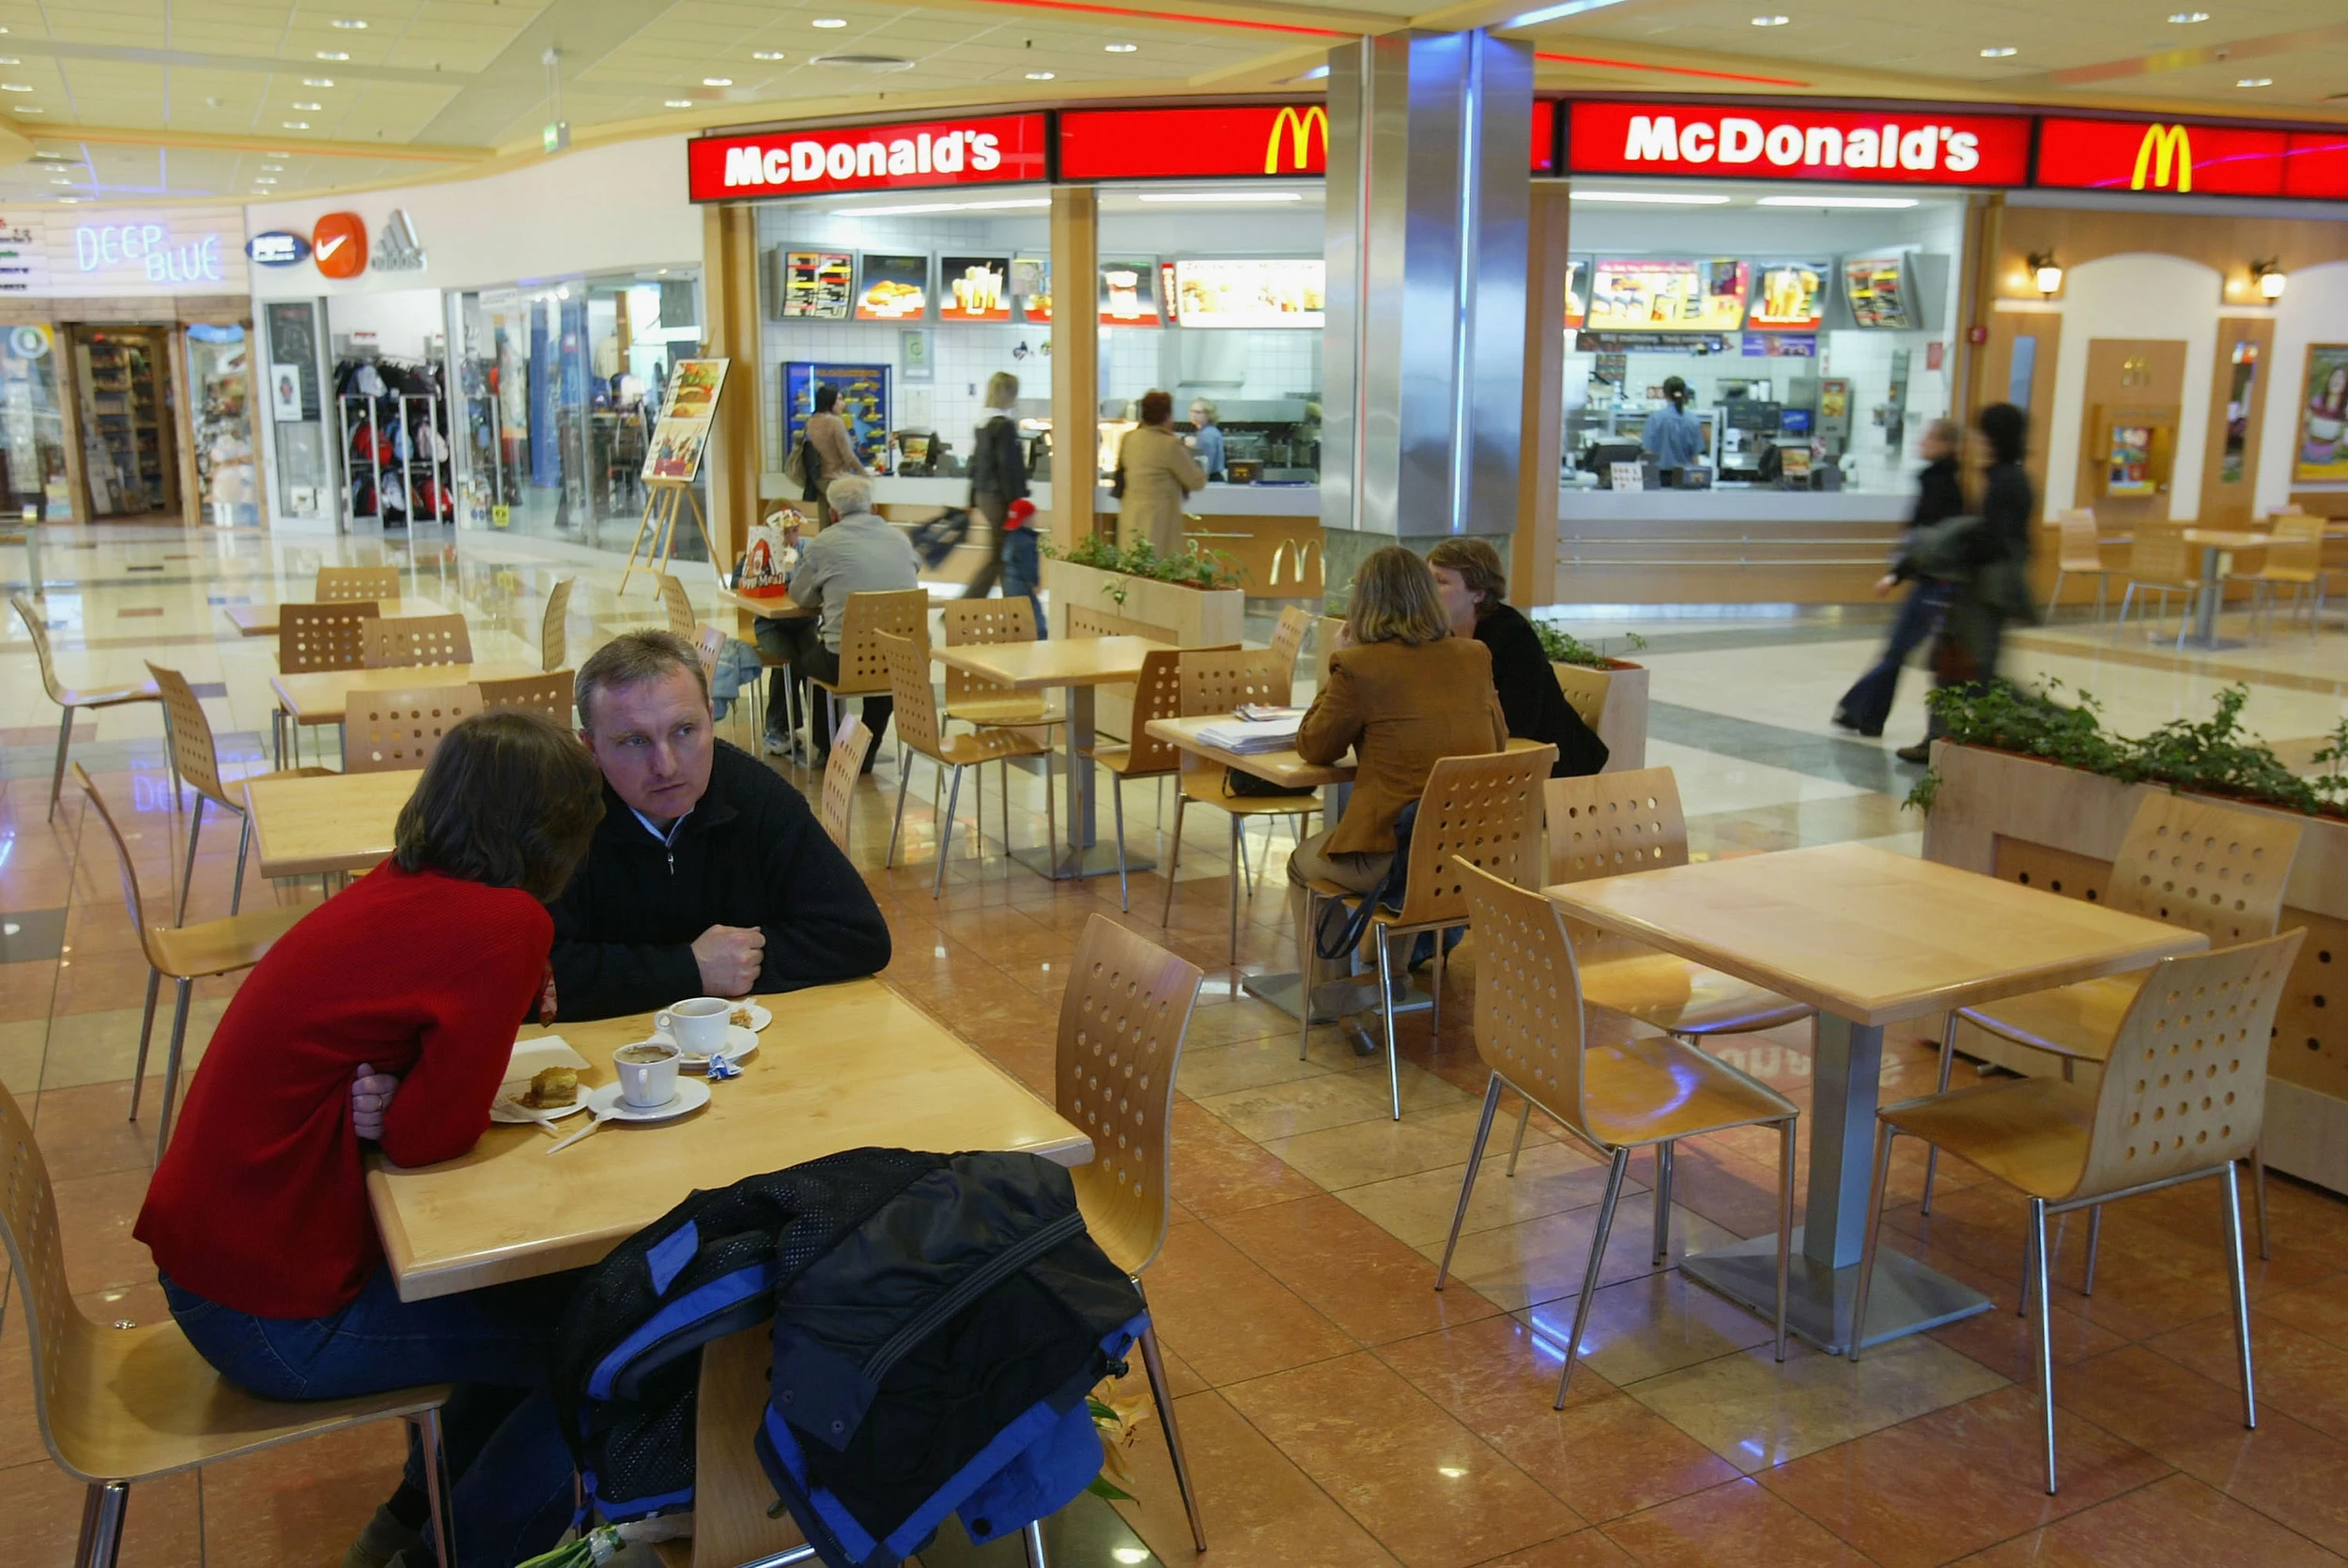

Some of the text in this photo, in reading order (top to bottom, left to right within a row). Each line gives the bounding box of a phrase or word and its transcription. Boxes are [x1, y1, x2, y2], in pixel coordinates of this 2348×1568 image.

[724, 130, 1001, 187] McDonald's
[1625, 115, 1979, 171] McDonald's
[76, 224, 162, 271] DEEP
[146, 236, 220, 282] BLUE
